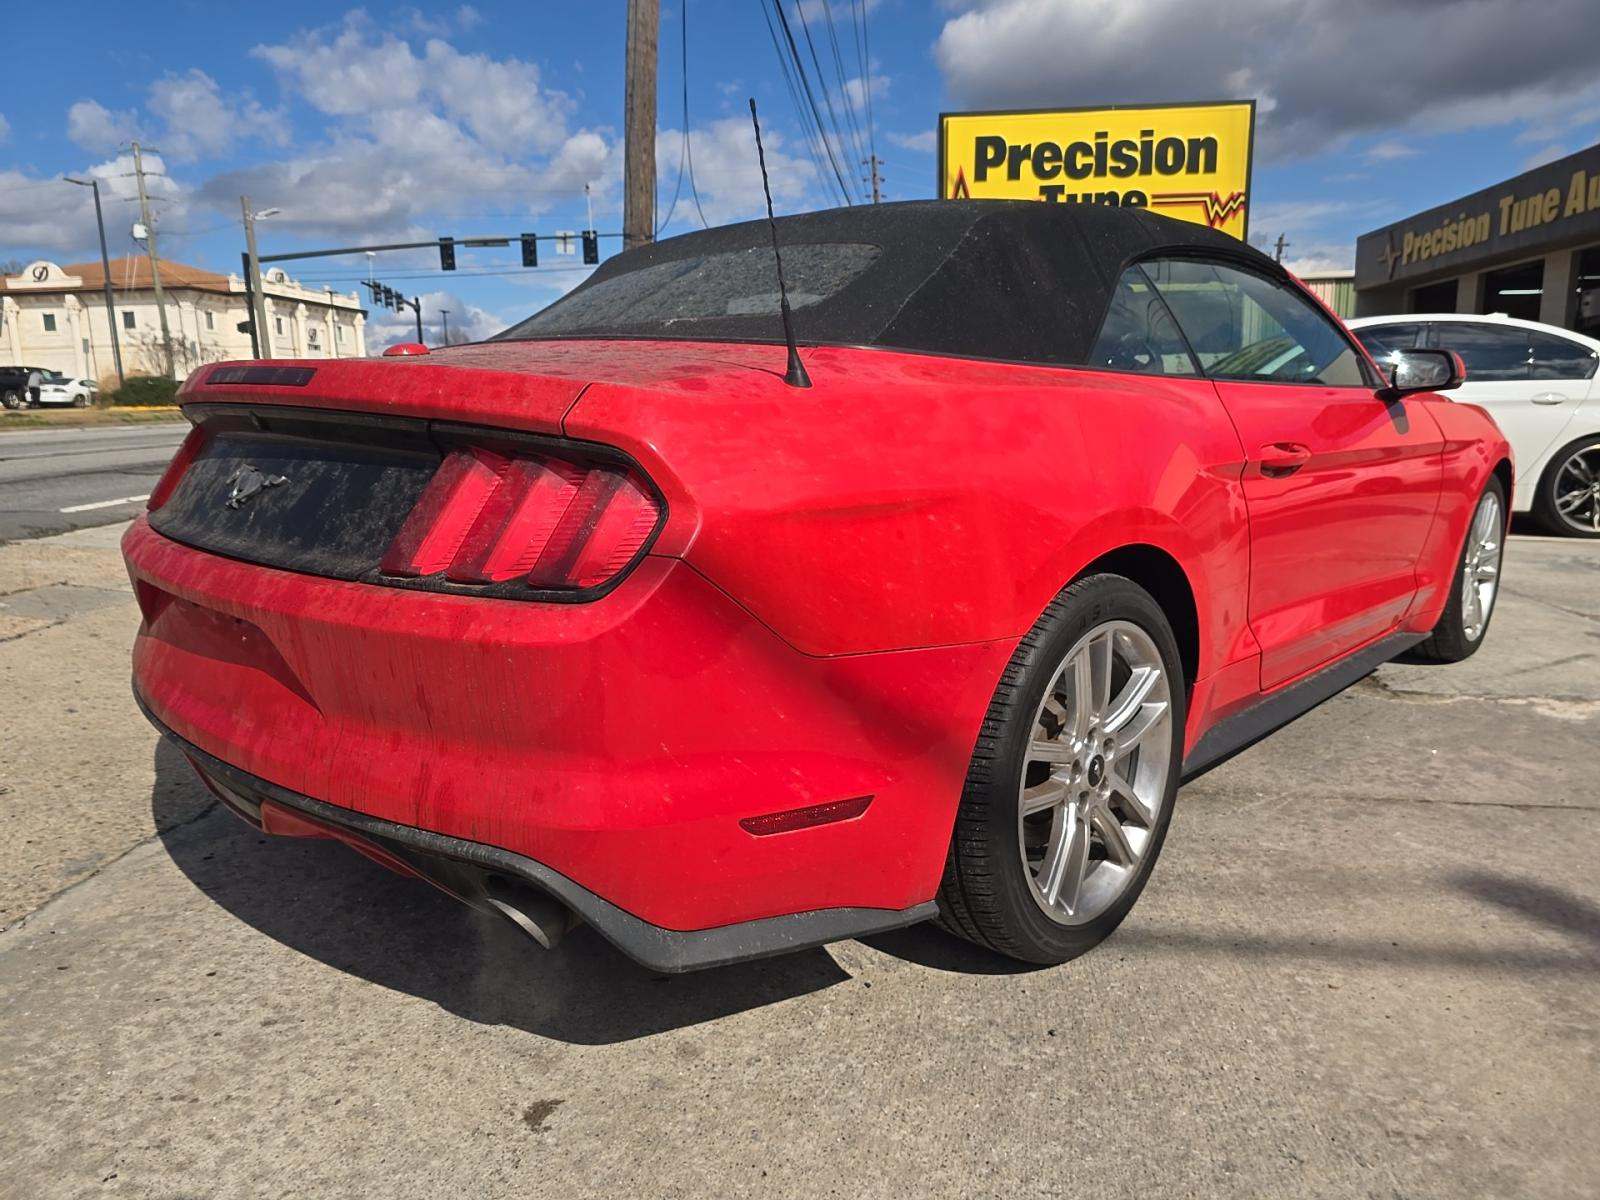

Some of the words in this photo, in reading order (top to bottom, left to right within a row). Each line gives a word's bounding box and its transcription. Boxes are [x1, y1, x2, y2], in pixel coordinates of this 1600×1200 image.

[974, 130, 1217, 181] Precision
[1402, 212, 1491, 264] Precision
[1499, 188, 1560, 235] Tune
